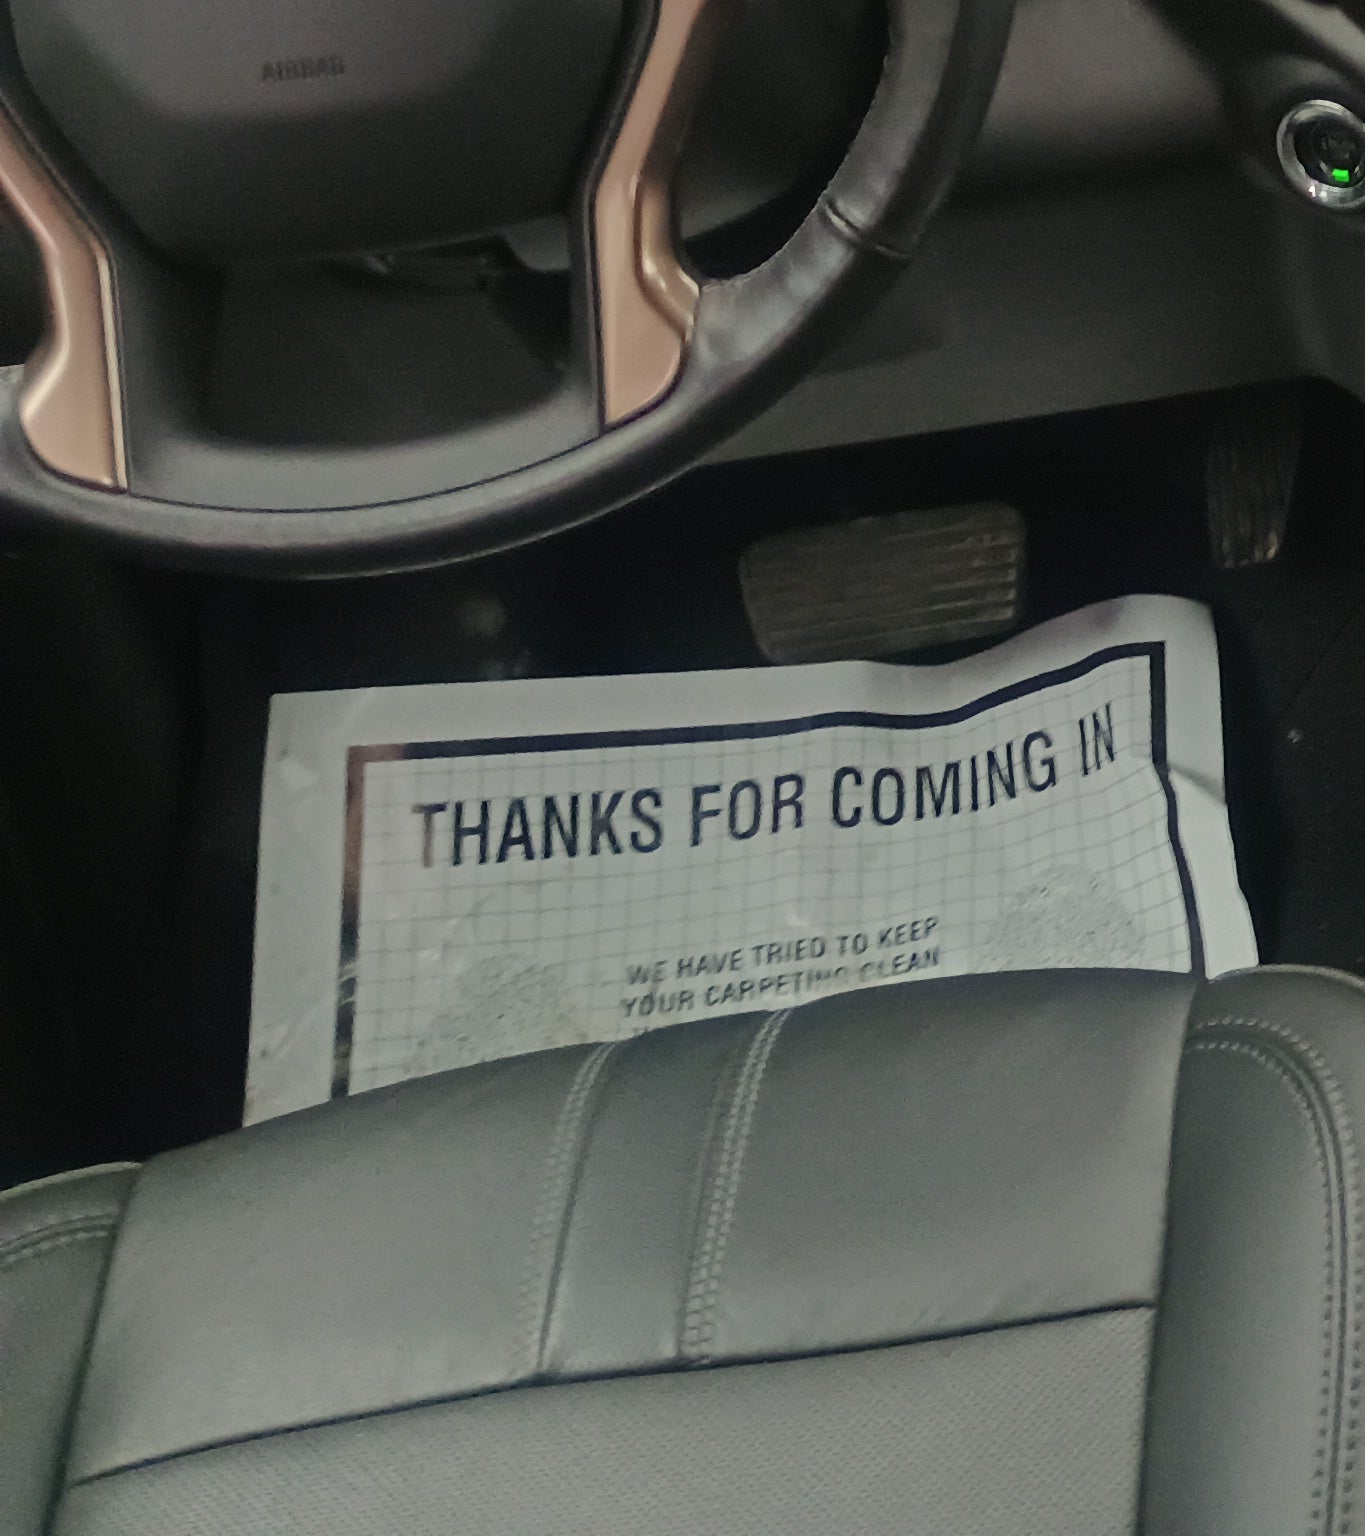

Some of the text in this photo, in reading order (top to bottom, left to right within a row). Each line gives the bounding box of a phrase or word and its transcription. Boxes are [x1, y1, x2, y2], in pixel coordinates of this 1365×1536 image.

[411, 702, 1117, 868] THANKS FOR COMING IN
[620, 988, 696, 1017] YOUR
[856, 946, 942, 983] CLEAN
[625, 916, 939, 986] WE HAVE TRIED TO KEEP
